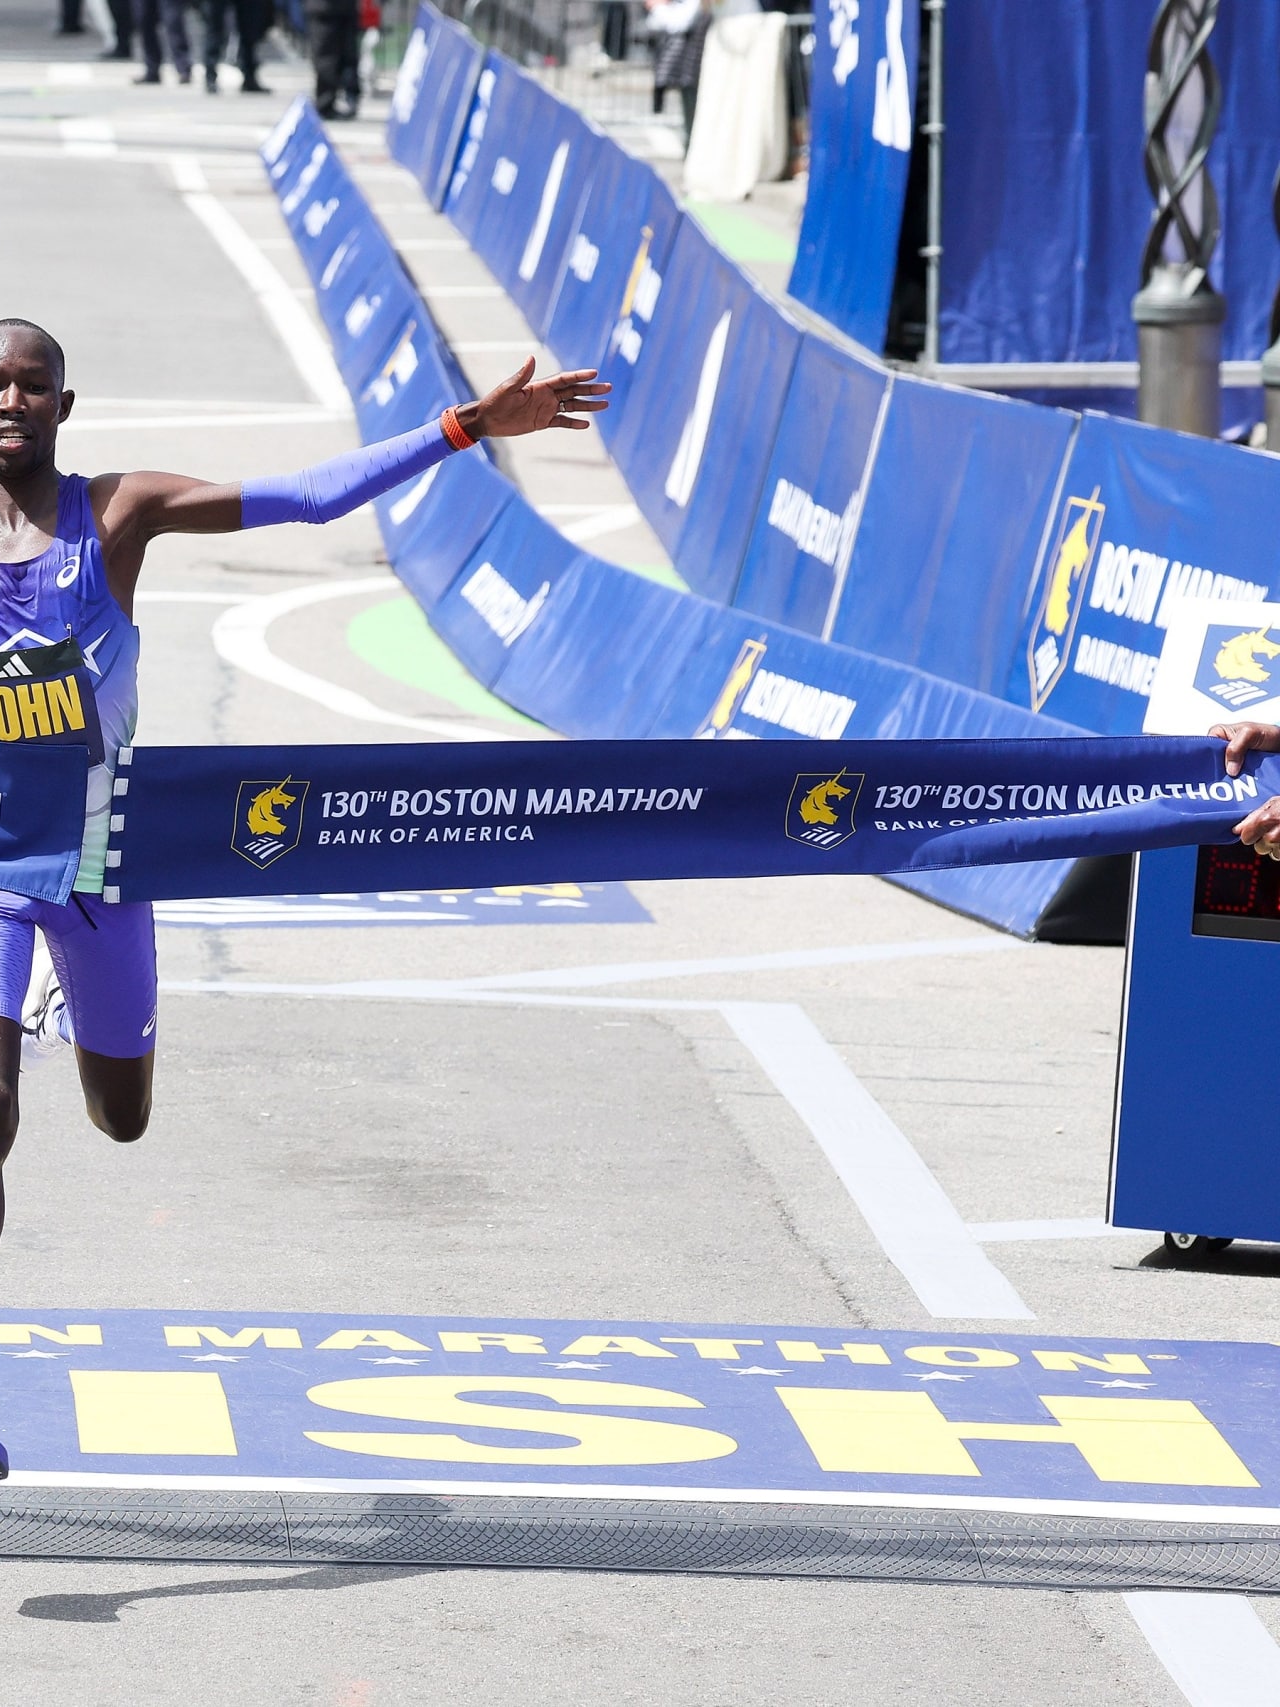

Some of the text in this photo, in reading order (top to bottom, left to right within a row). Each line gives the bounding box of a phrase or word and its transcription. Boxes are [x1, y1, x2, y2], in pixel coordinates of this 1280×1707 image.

[322, 788, 703, 817] 130TH BOSTON MARATHON
[875, 775, 1259, 810] 130TH BOSTON MARATHON
[318, 826, 534, 844] BANK OF AMERICA
[874, 820, 942, 832] BANK
